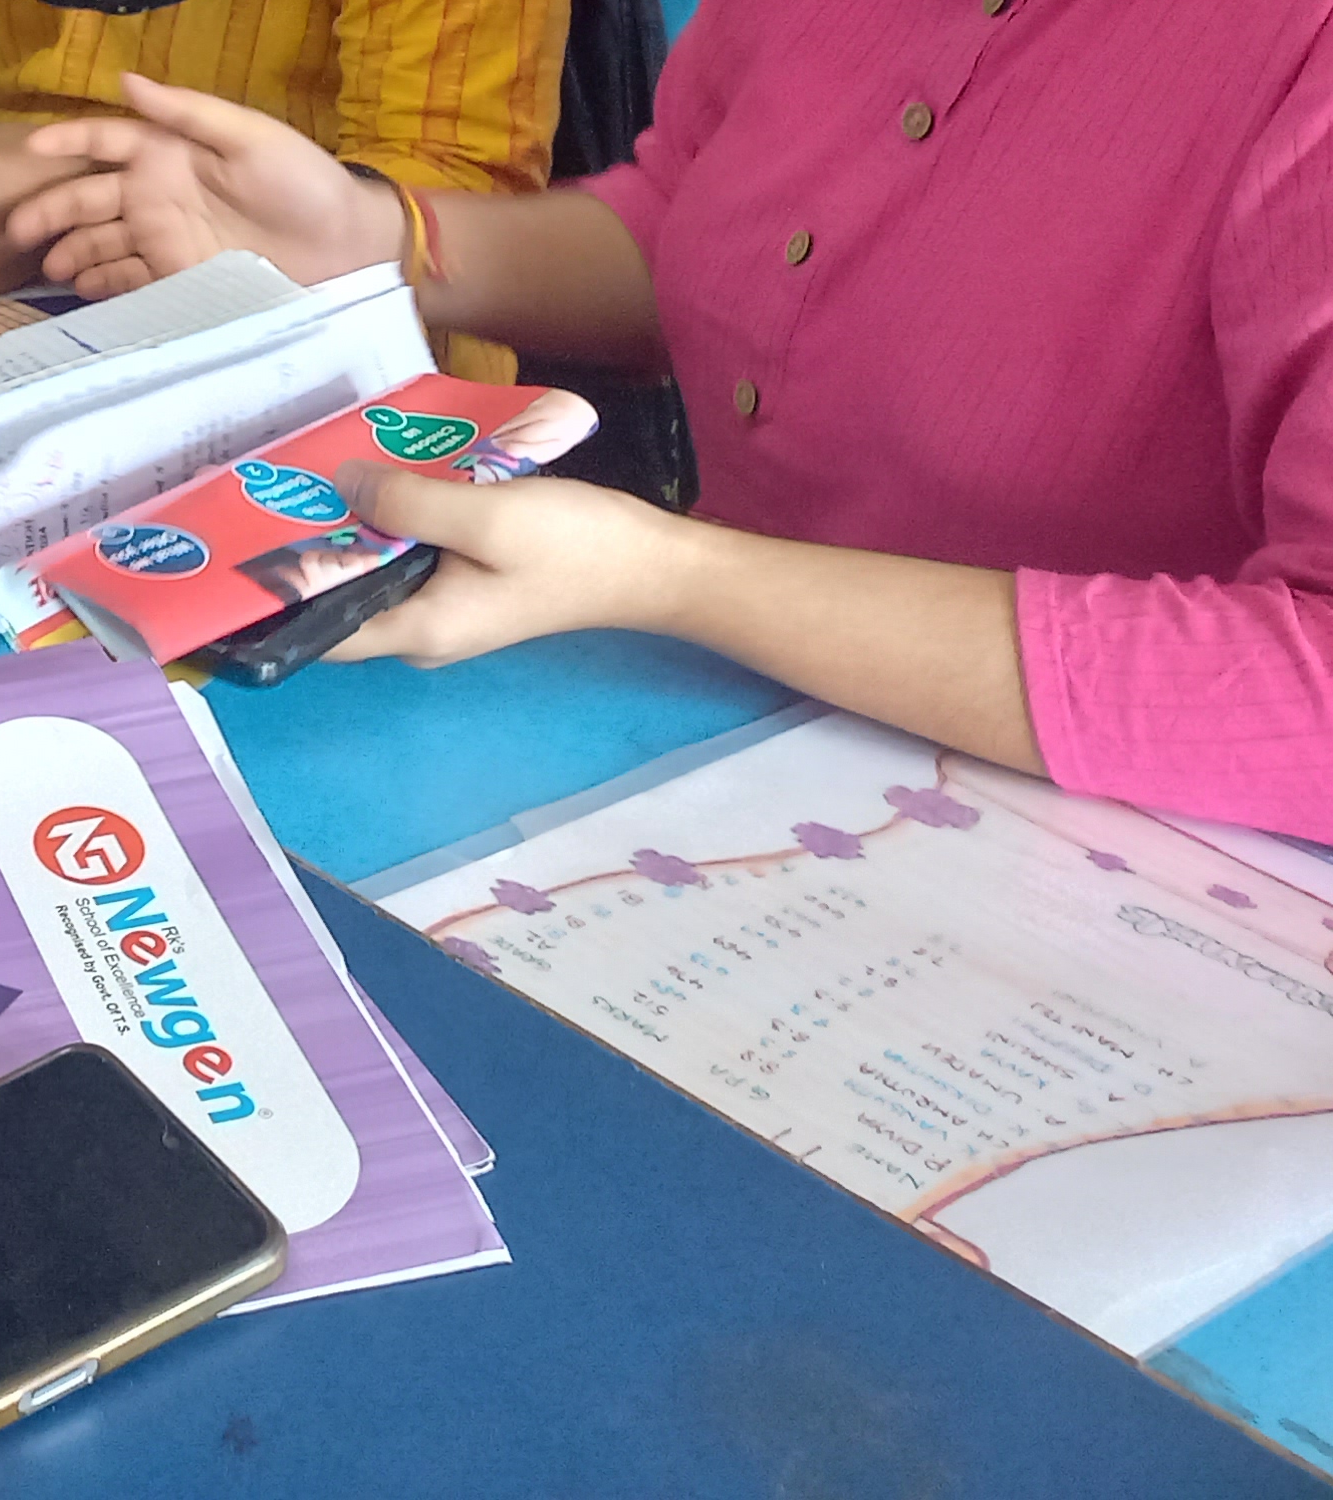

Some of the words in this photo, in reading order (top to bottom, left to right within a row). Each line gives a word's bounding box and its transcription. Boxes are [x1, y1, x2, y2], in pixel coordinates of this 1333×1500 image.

[75, 897, 106, 938] School
[98, 938, 112, 954] of
[55, 904, 90, 960] Recognised
[83, 960, 97, 974] by
[106, 1001, 121, 1018] Of
[104, 952, 146, 1019] Excellence
[92, 886, 256, 1125] Newgen
